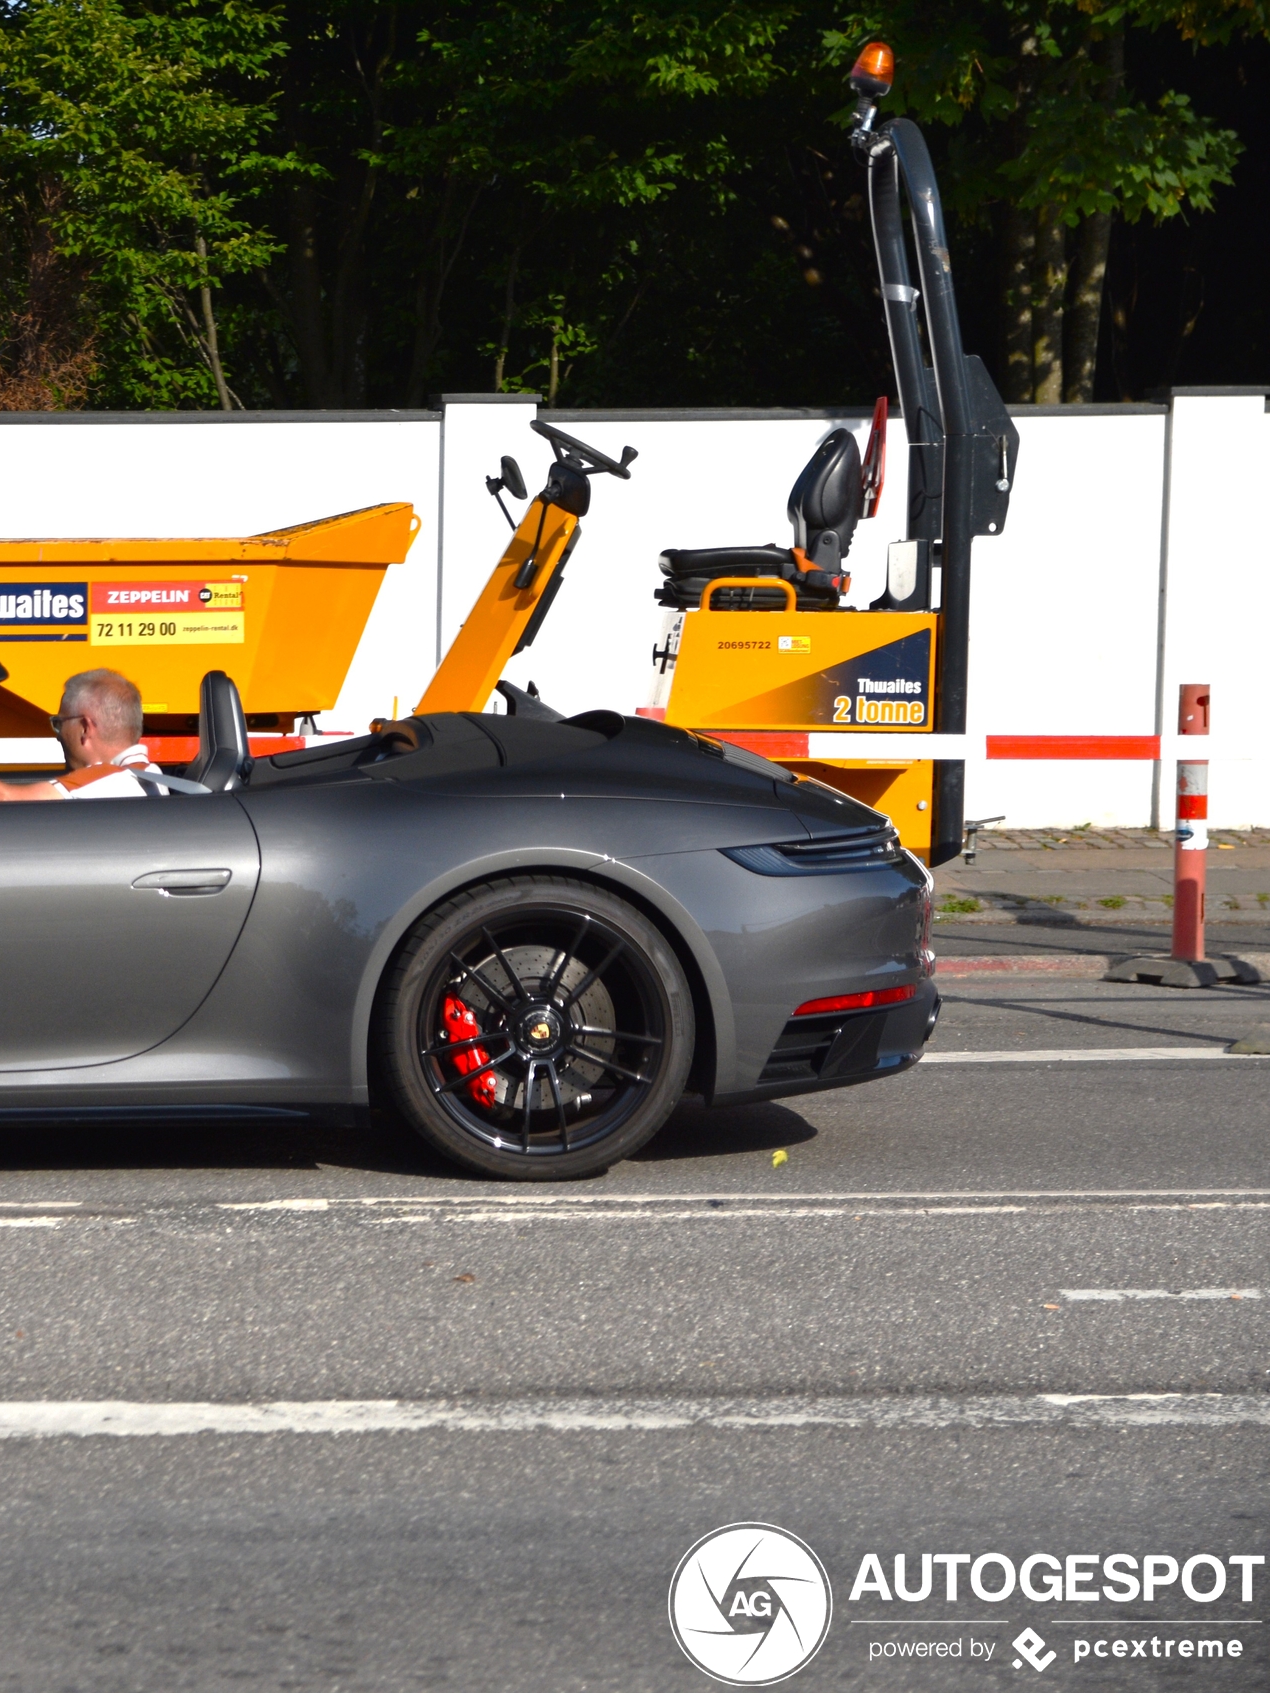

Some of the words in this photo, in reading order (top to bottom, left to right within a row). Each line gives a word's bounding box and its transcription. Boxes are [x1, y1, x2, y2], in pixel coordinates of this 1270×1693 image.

[107, 590, 189, 604] ZEPPELIN
[214, 591, 239, 599] Rental
[97, 623, 113, 637] 72
[118, 623, 133, 637] 11
[138, 622, 155, 636] 29
[159, 621, 176, 636] 00
[717, 641, 771, 650] 20695722
[857, 678, 922, 694] Thwaites
[833, 695, 852, 723] 2
[856, 696, 925, 724] tonne
